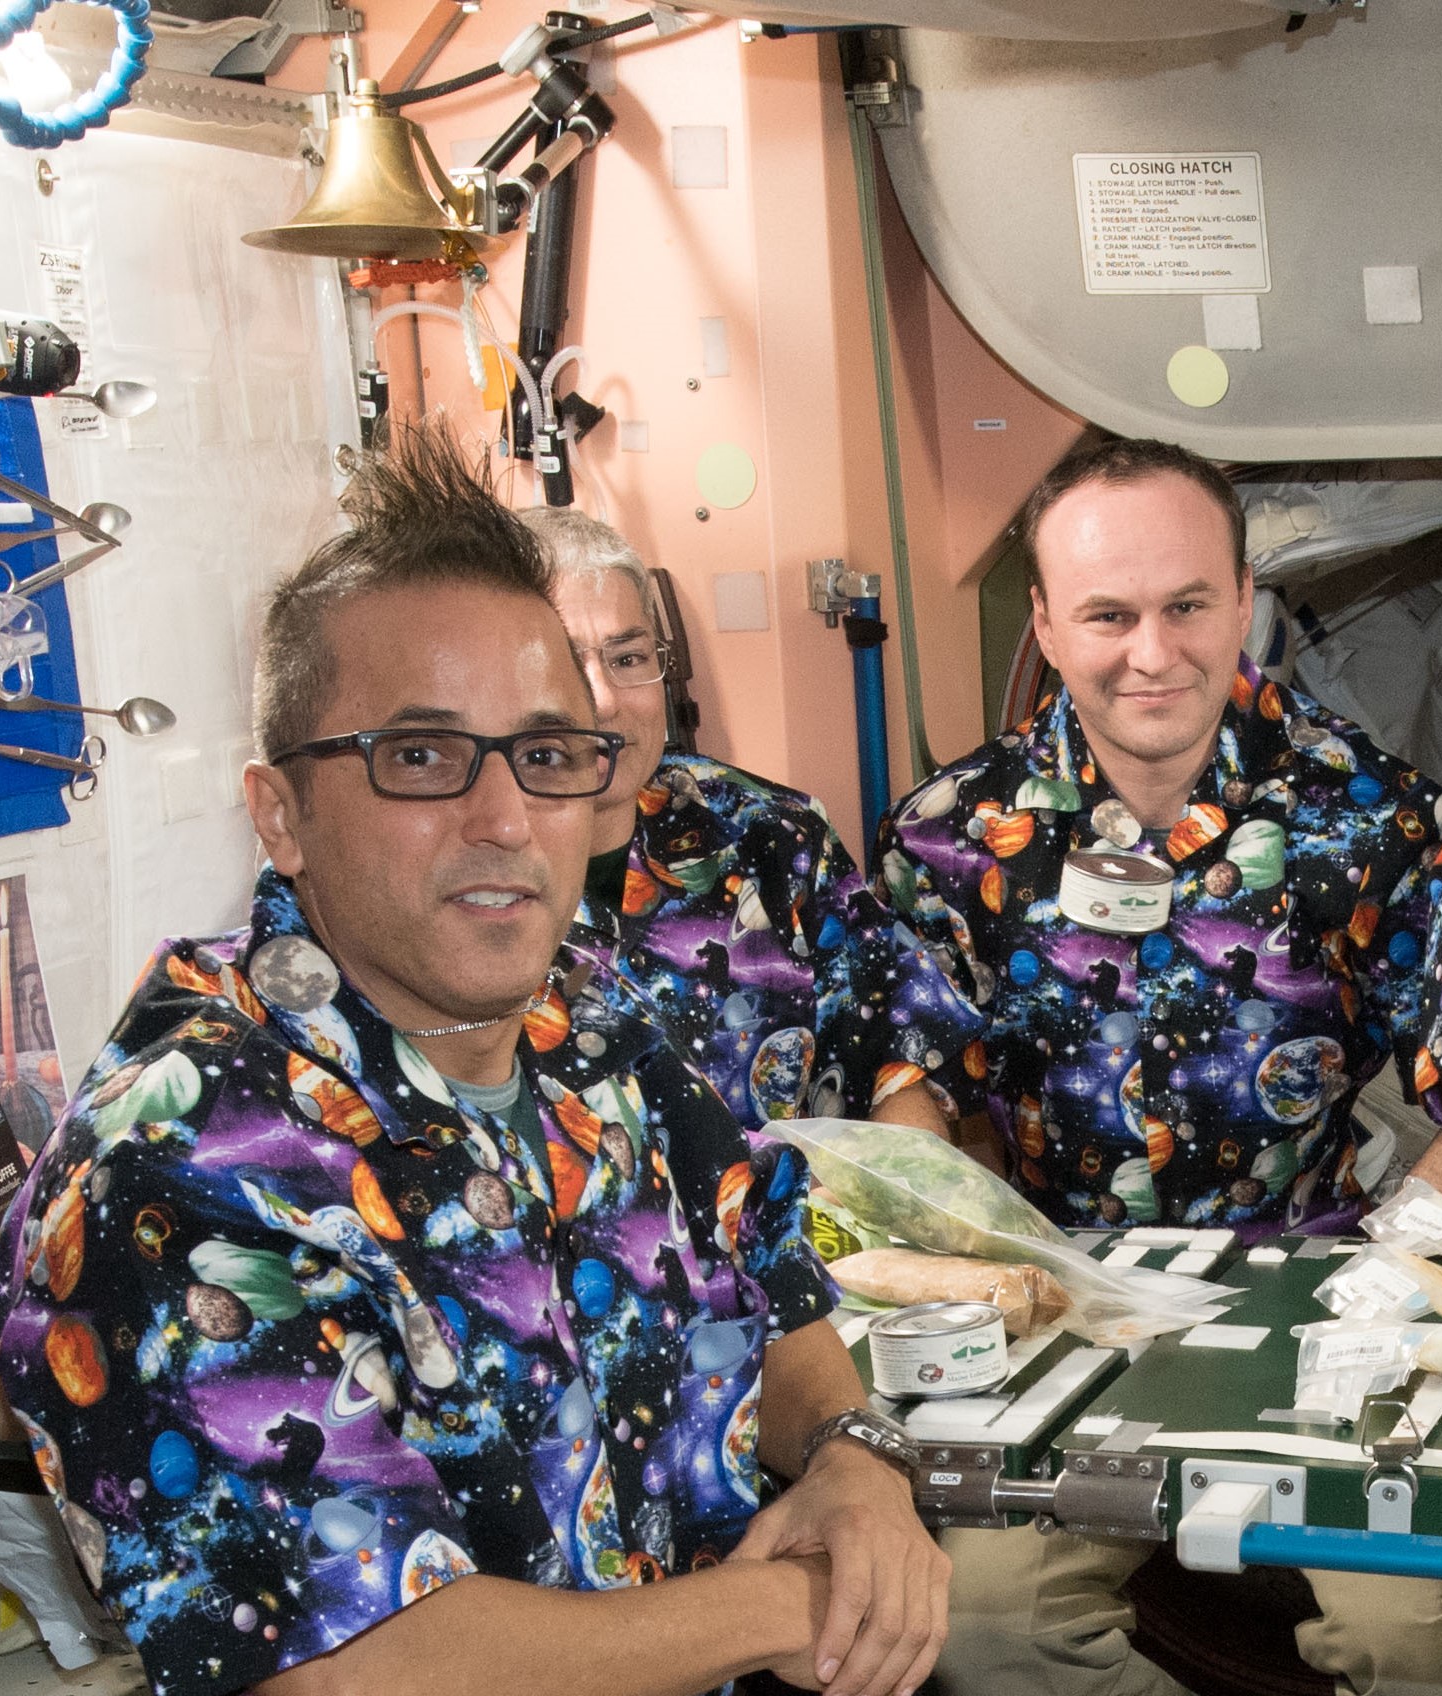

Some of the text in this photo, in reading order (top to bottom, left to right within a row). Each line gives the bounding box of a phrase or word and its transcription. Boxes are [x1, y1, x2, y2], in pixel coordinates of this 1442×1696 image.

[1110, 161, 1232, 175] CLOSING HATCH
[1169, 234, 1200, 242] Engaged
[932, 1474, 959, 1483] LOCK
